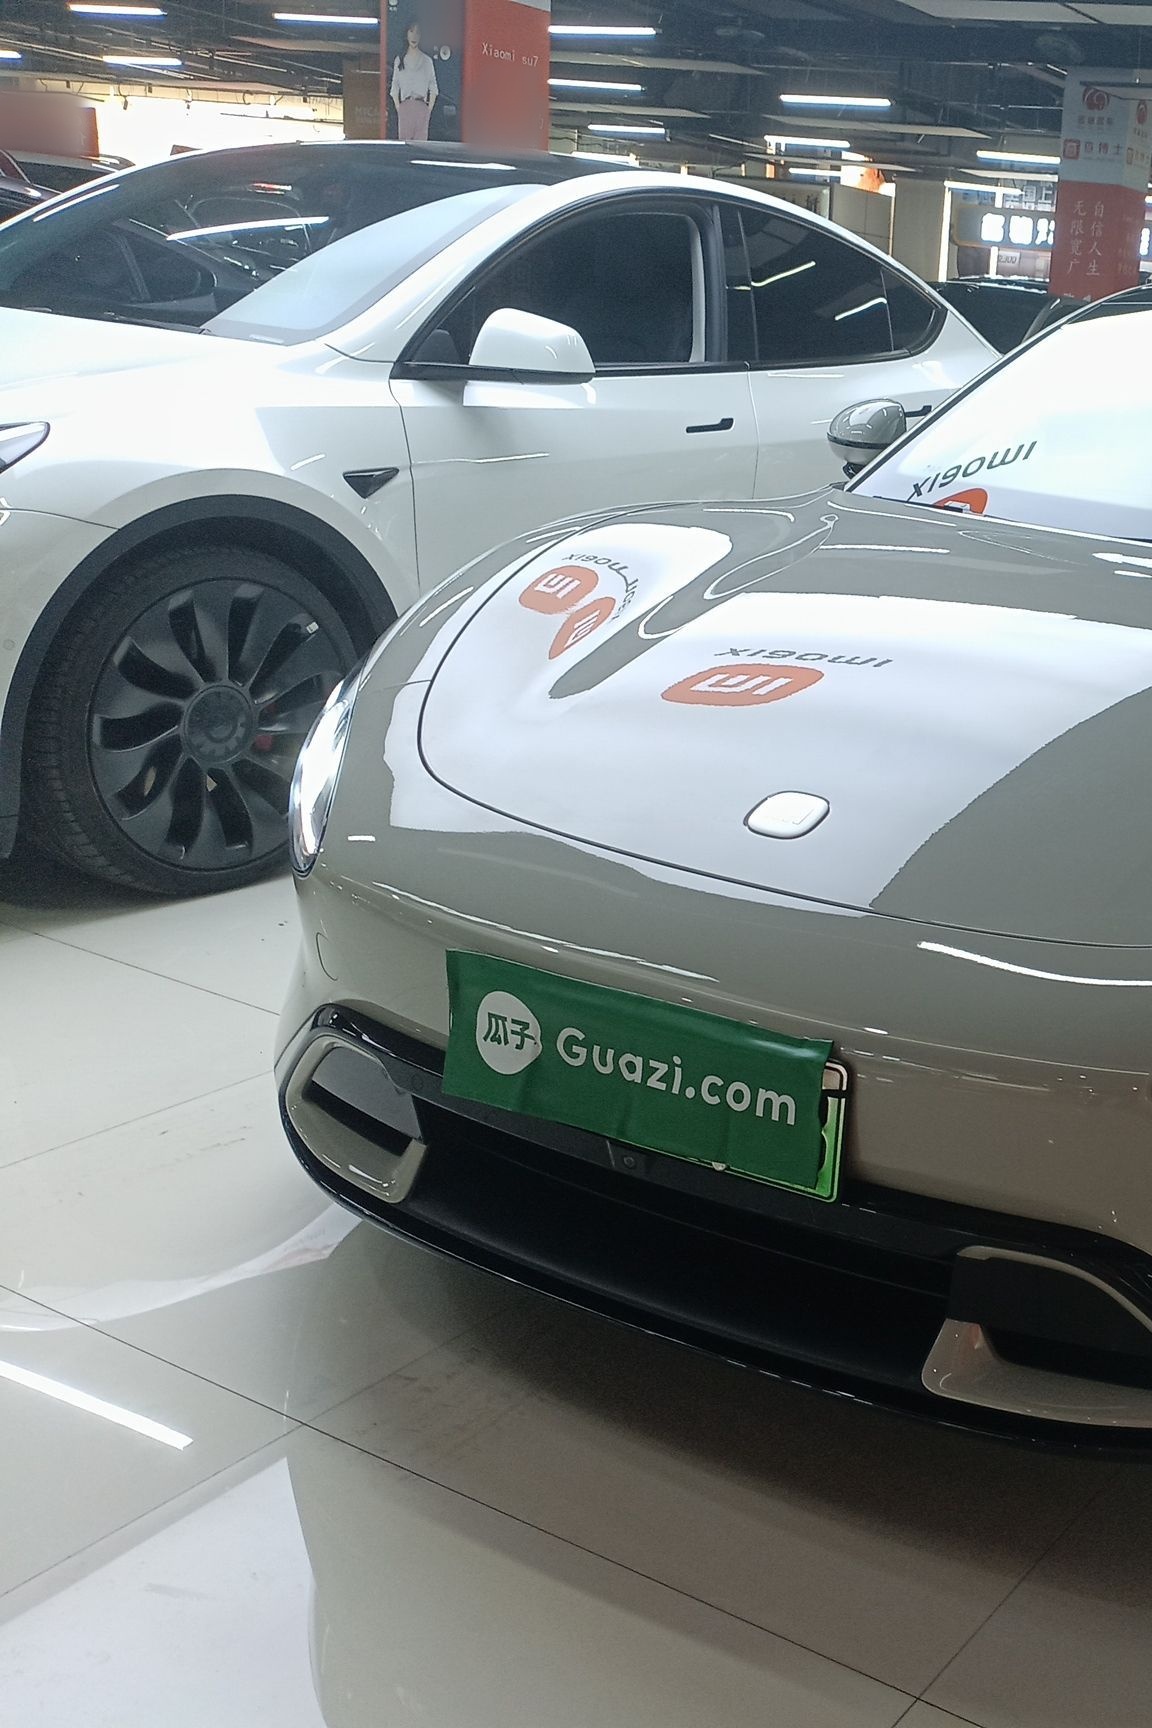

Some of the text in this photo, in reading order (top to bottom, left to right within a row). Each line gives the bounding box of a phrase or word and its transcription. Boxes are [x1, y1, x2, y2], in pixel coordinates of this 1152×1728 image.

[481, 42, 540, 67] Xiaomi su7
[1066, 200, 1087, 275] 无限宽广
[1086, 201, 1105, 276] 自信人生
[482, 1011, 537, 1051] 瓜子
[556, 1026, 797, 1126] Guazi.com
